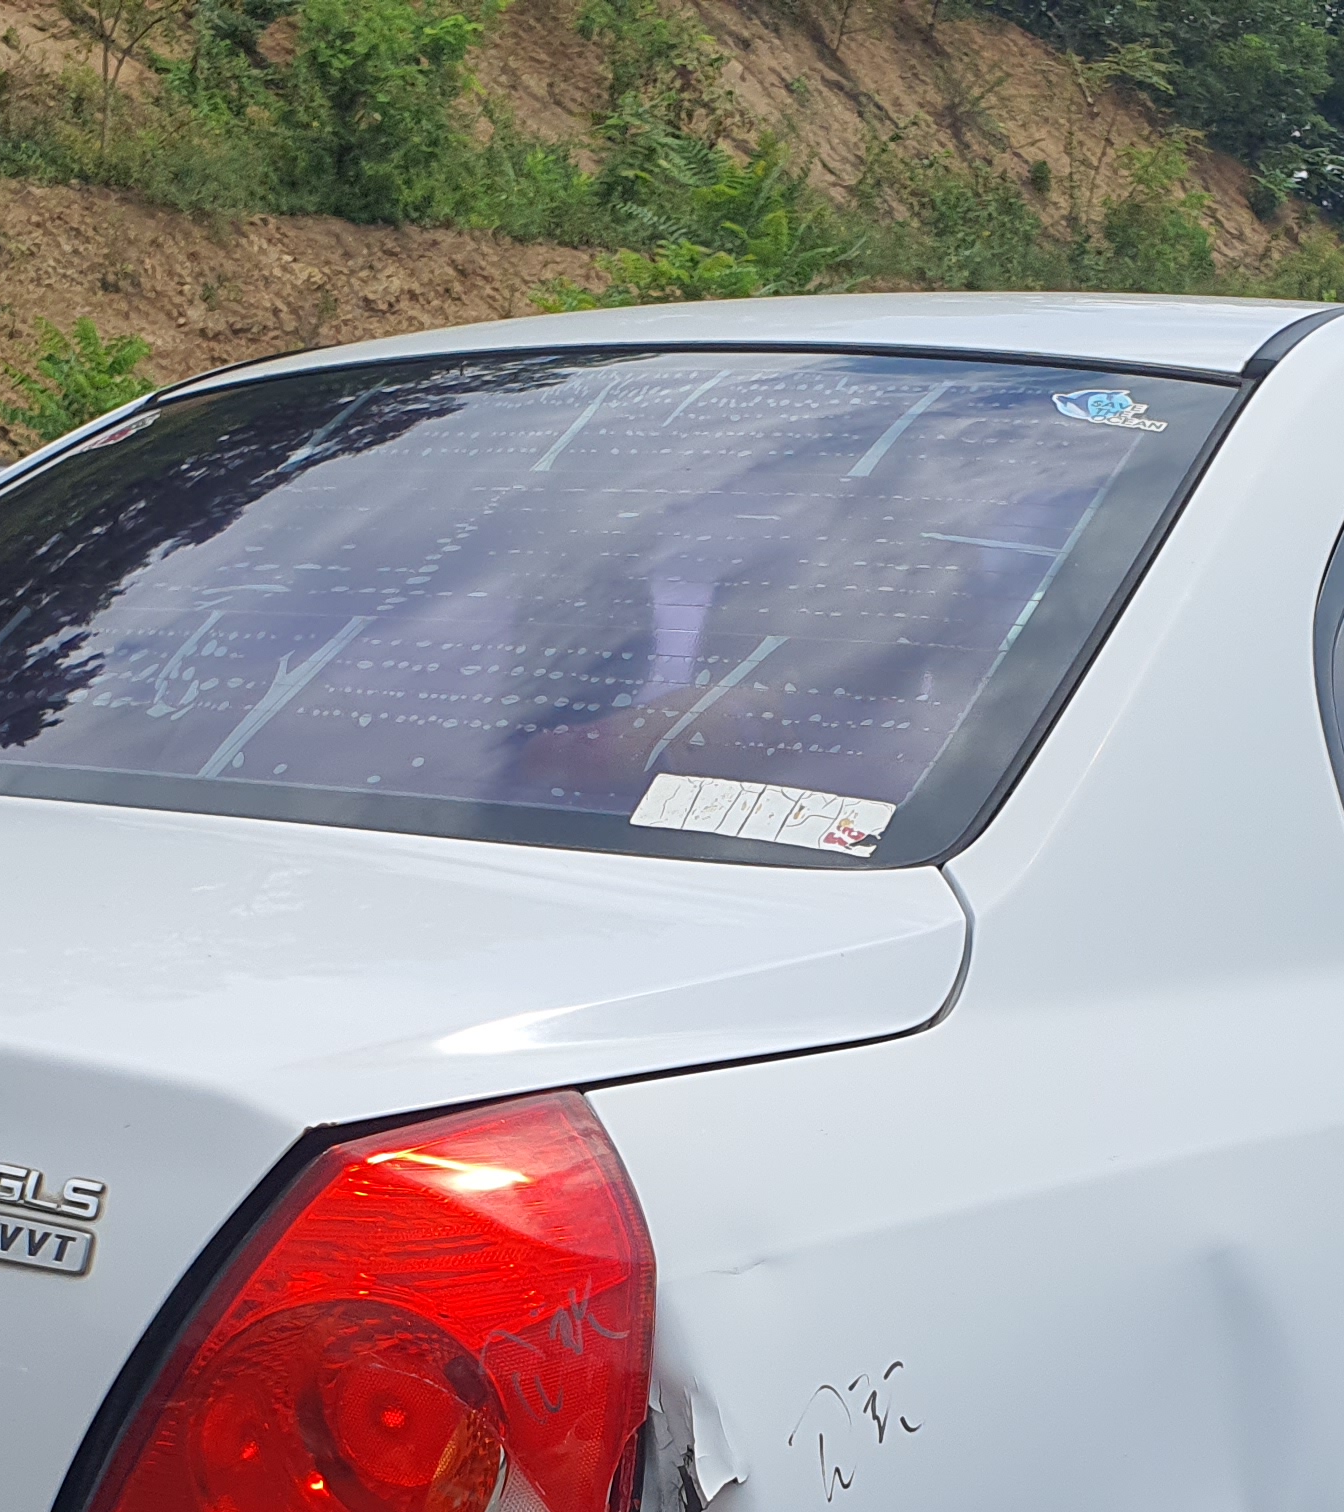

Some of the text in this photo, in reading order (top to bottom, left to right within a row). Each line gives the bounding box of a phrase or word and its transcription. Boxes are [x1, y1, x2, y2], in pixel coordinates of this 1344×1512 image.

[1090, 399, 1145, 412] SAVE
[1090, 414, 1164, 430] OCEAN
[0, 1222, 77, 1263] VVT
